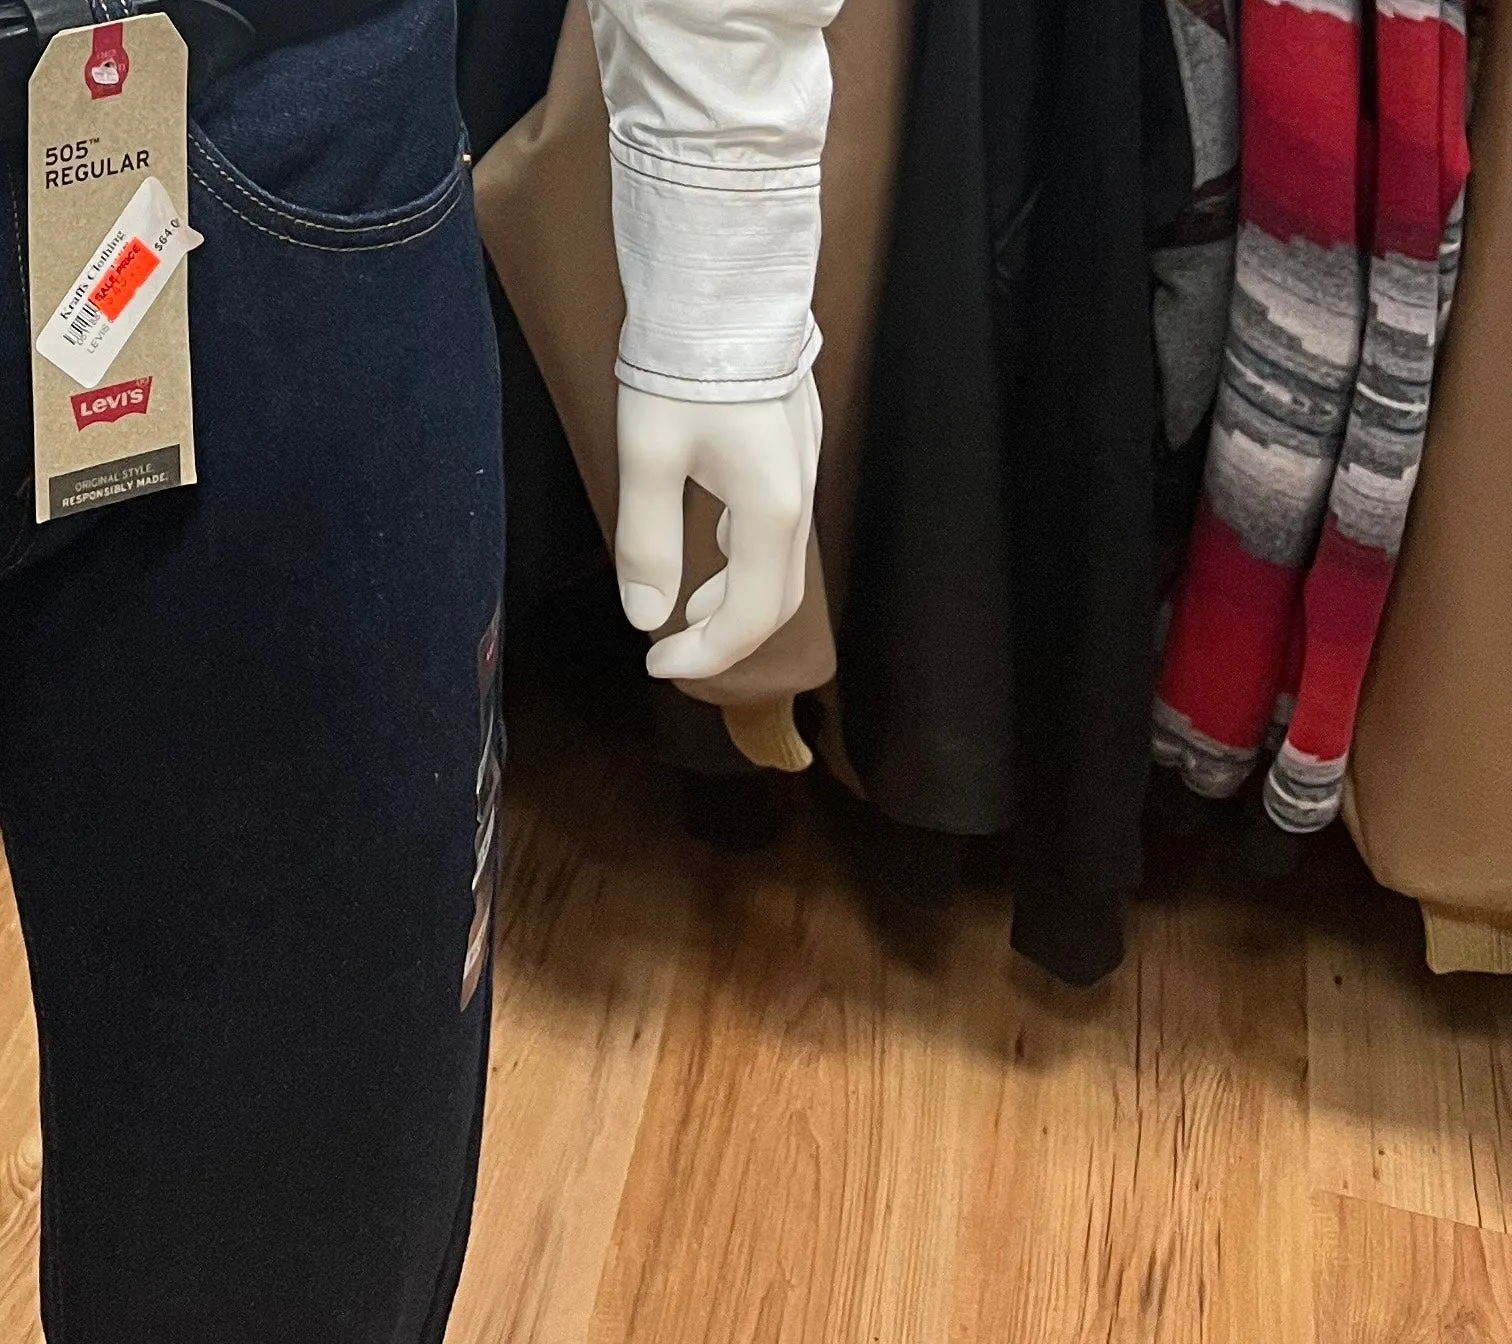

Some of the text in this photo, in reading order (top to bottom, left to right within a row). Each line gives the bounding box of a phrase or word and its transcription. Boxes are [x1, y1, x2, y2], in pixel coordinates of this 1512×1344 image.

[45, 149, 150, 189] REGULAR
[87, 230, 127, 281] Clothing
[115, 243, 142, 276] PRICE
[86, 325, 111, 354] LEVIS
[61, 481, 137, 508] RESPONSIBLY
[74, 473, 120, 493] ORIGINAL
